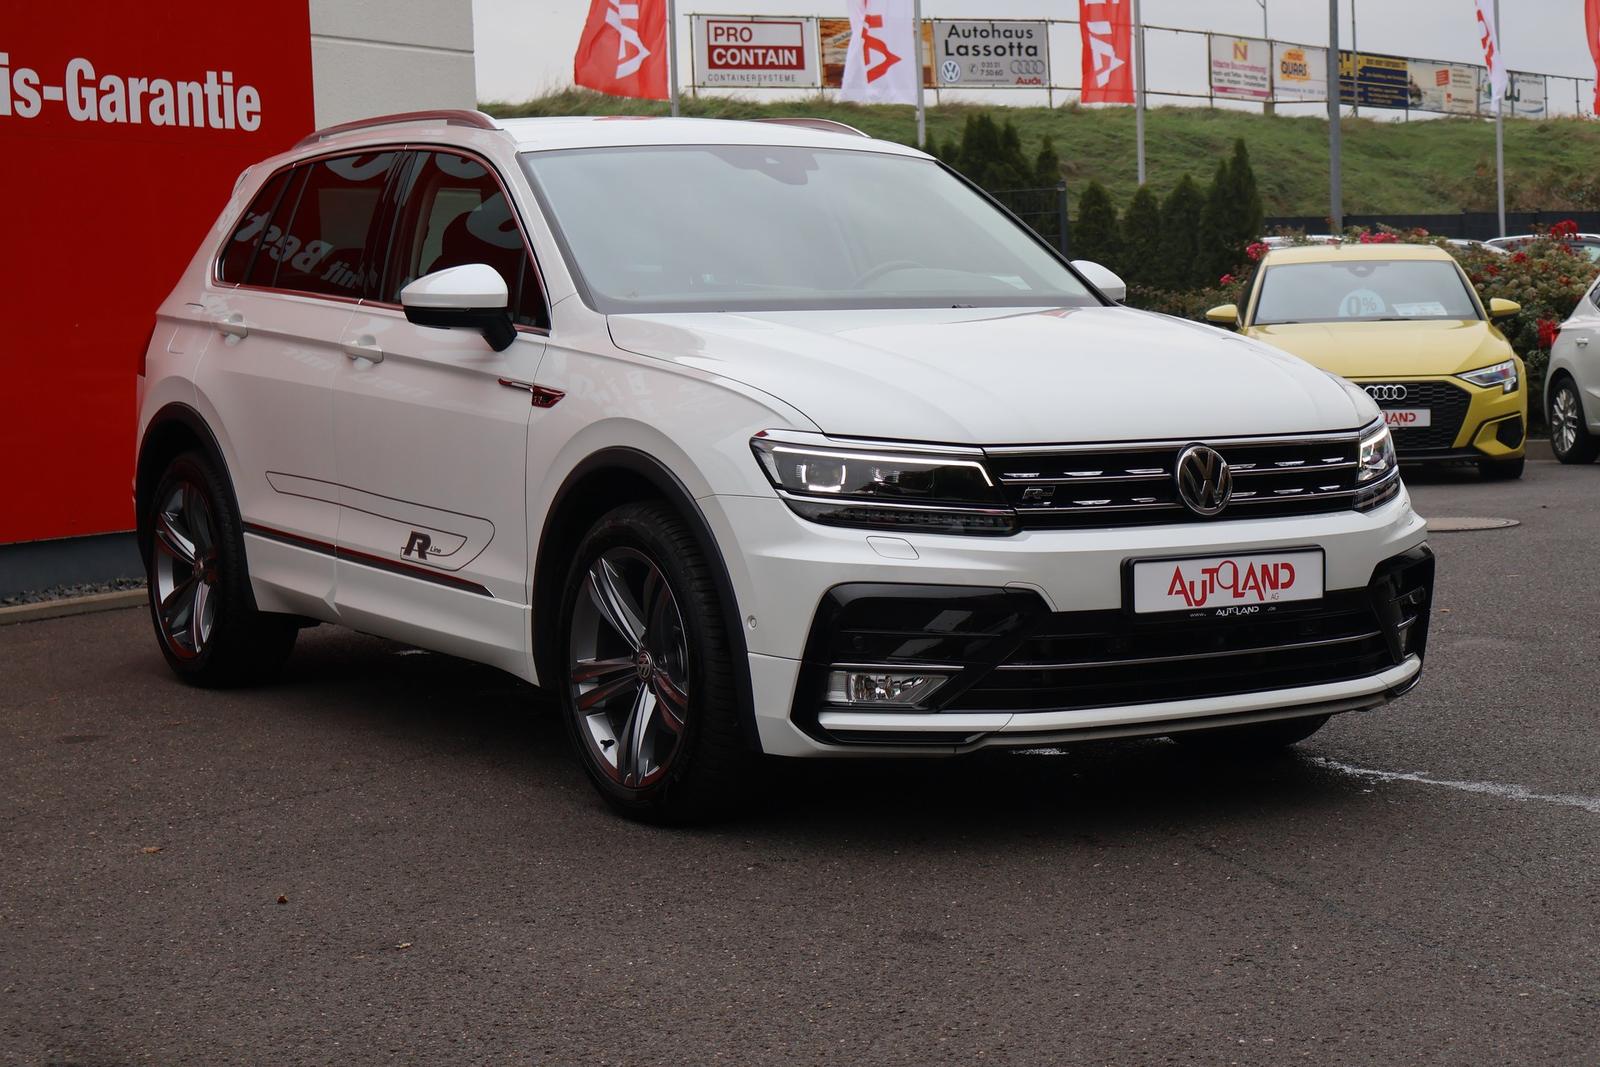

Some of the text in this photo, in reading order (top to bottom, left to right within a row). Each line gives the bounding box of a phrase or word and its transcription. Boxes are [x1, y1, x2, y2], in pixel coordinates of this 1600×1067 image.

[713, 26, 753, 43] PRO
[948, 23, 1033, 39] Autohaus
[712, 48, 798, 66] CONTAIN
[945, 40, 1037, 57] Lassotta
[1233, 43, 1248, 60] N
[707, 74, 796, 82] CONTAINERSYSTEME
[1016, 77, 1042, 85] Audi
[403, 531, 431, 560] R
[1167, 560, 1296, 607] AUTOLAND
